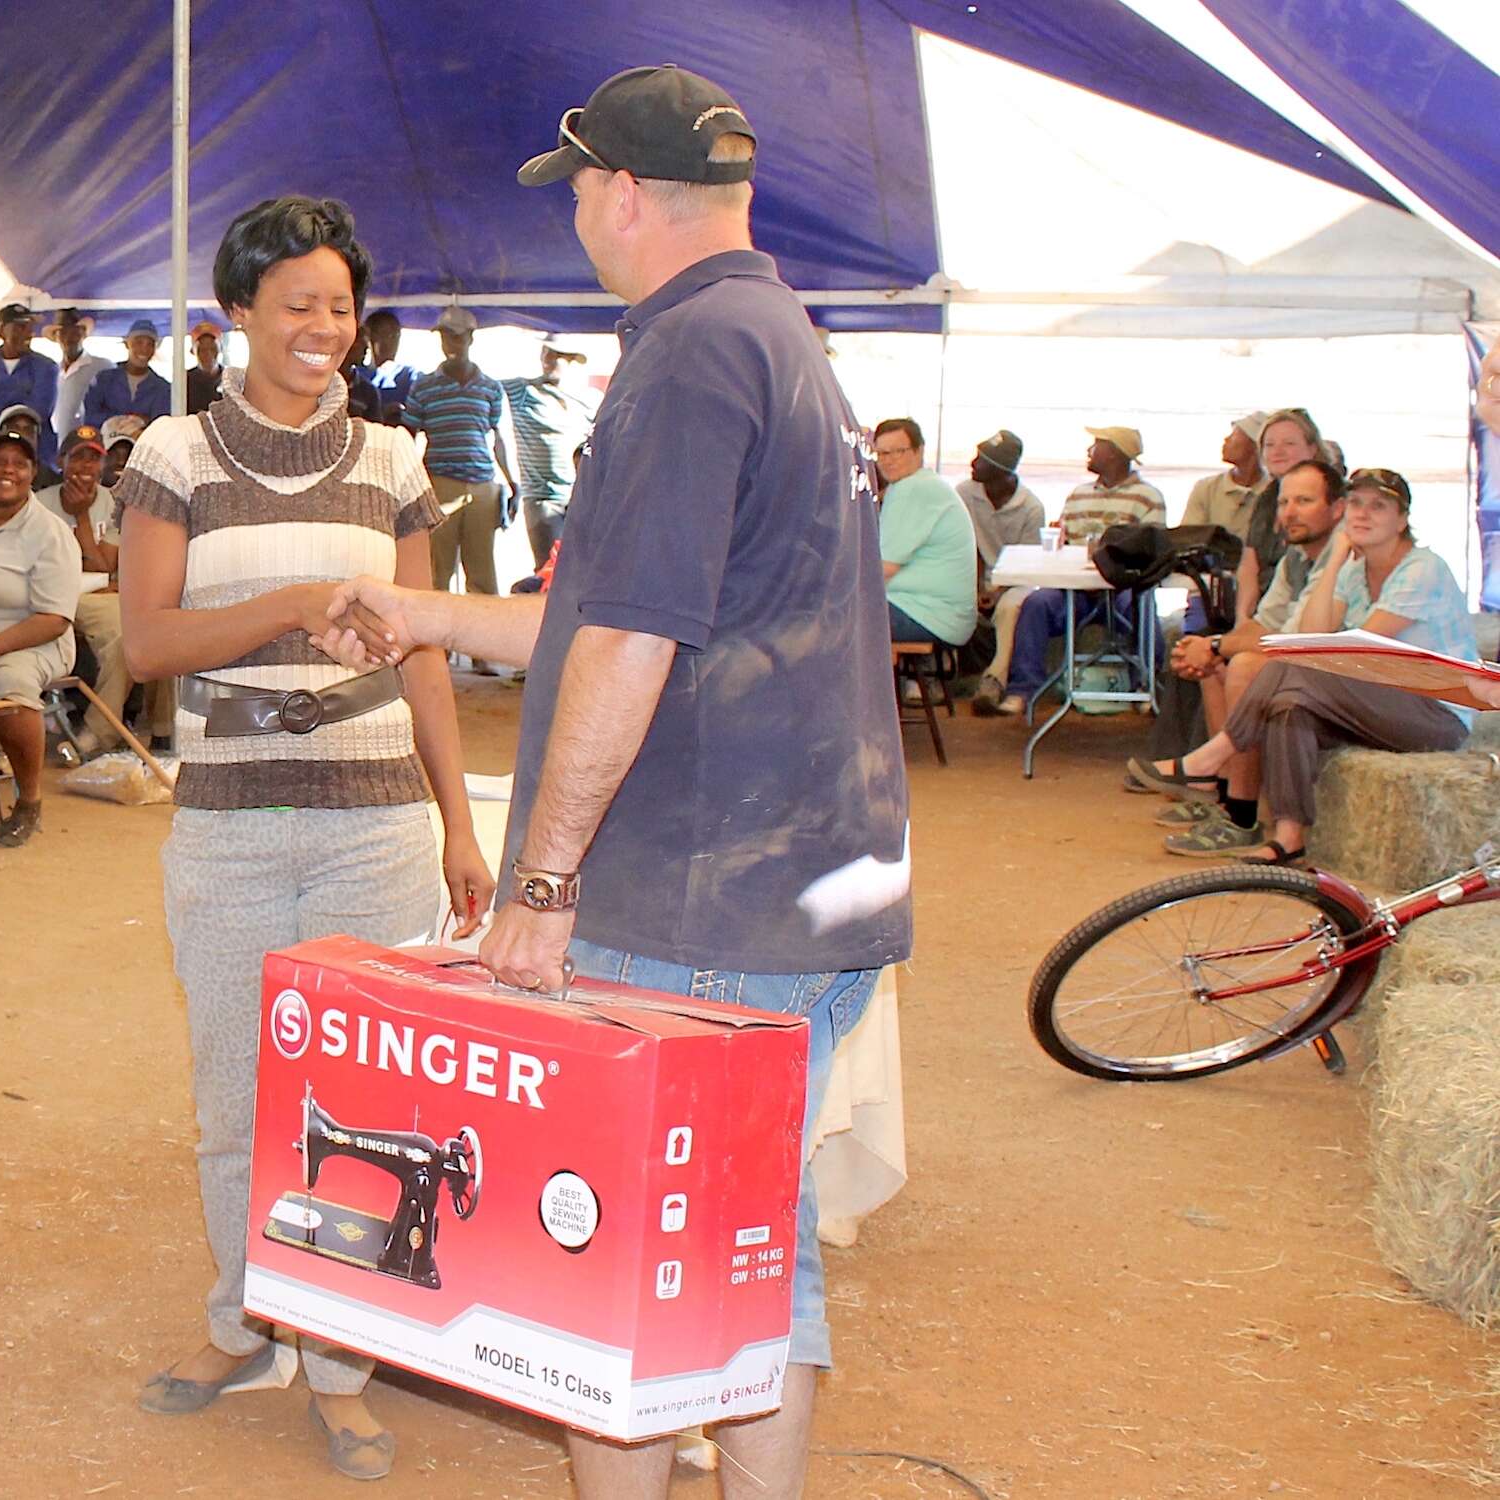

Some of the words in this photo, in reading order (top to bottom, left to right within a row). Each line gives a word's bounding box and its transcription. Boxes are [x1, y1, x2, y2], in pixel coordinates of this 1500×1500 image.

[355, 1136, 400, 1157] SINGER
[558, 1186, 581, 1200] BEST
[551, 1195, 589, 1214] QUALITY
[552, 1206, 586, 1224] SEWING
[548, 1216, 589, 1236] MACHINE
[731, 1252, 750, 1269] NW
[730, 1270, 749, 1285] GW
[474, 1343, 535, 1379] MODEL
[541, 1366, 560, 1387] 15
[565, 1374, 613, 1405] Class
[636, 1393, 716, 1417] www.singer.com
[733, 1380, 773, 1399] SINGER
